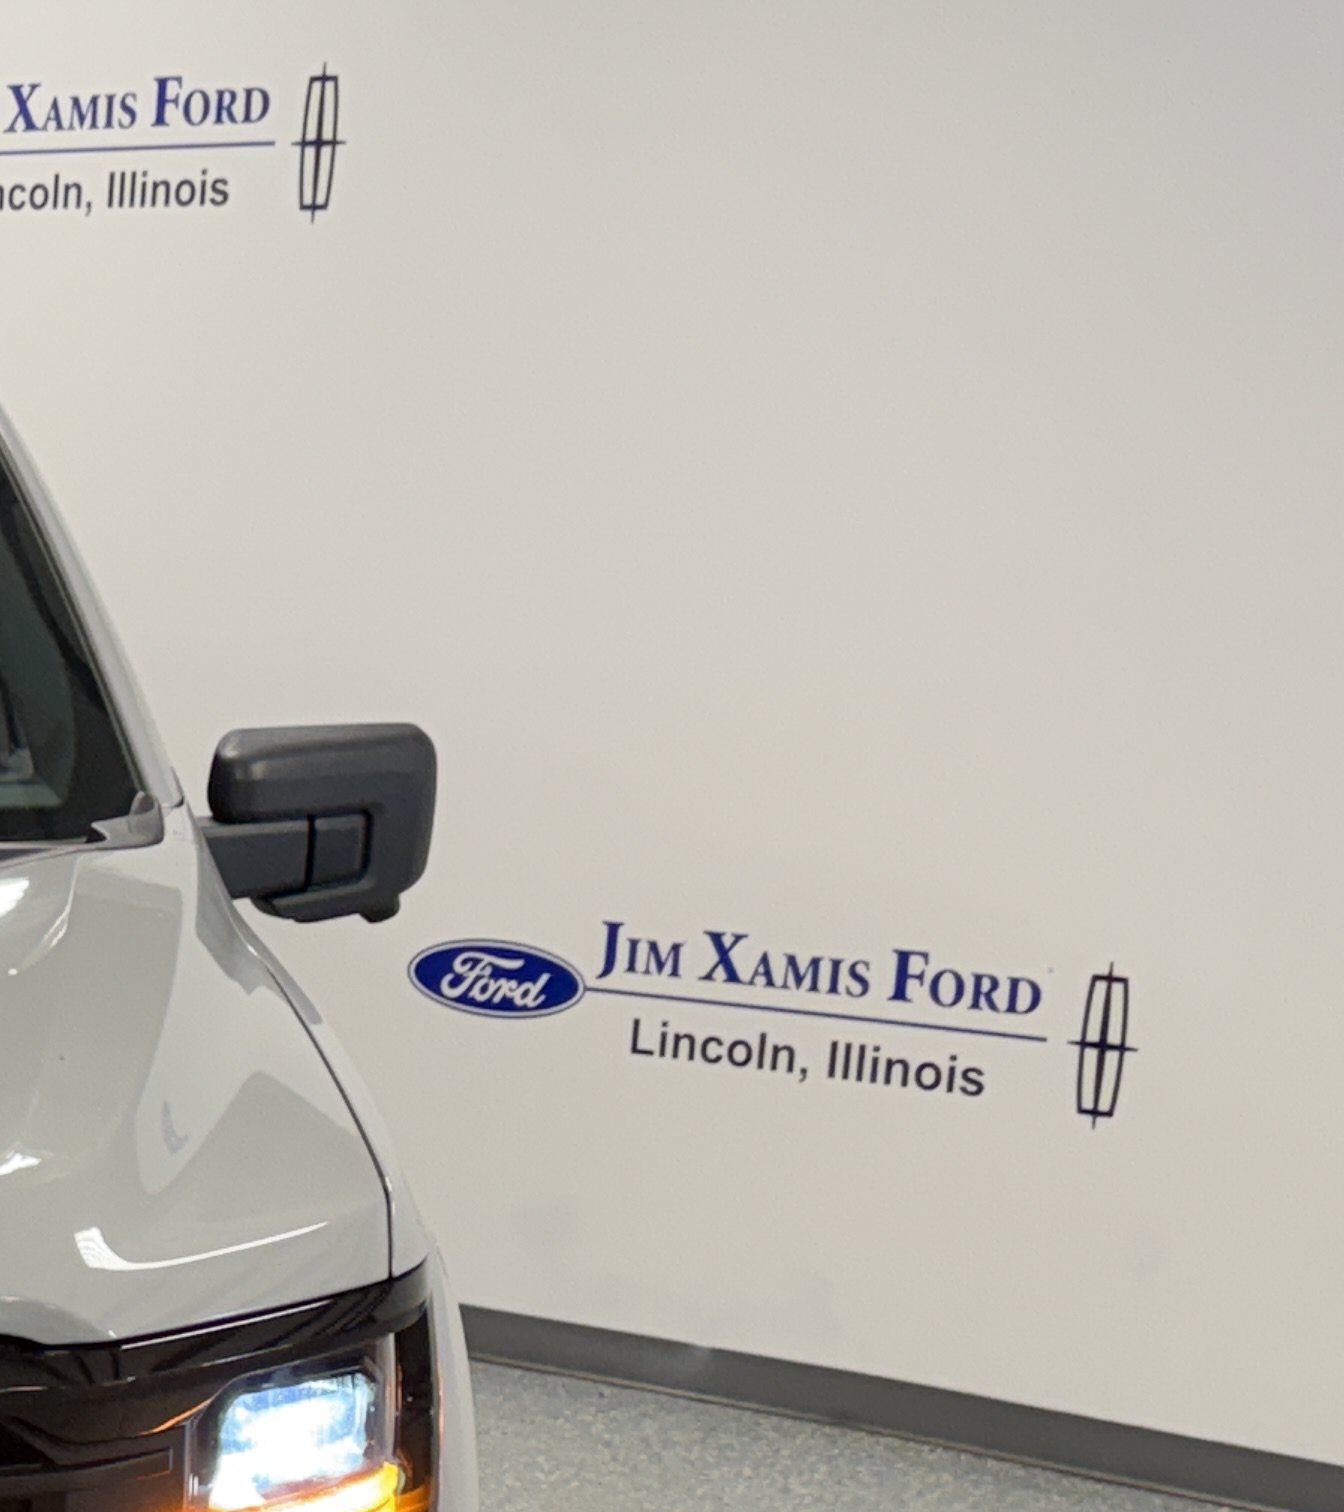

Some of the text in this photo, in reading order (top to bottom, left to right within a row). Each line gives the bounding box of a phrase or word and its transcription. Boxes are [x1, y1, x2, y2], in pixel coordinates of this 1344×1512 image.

[3, 82, 138, 134] XAMIS
[150, 75, 271, 128] FORD
[107, 168, 230, 209] Illinois
[438, 948, 548, 1012] Ford
[595, 920, 1043, 1016] JIM XAMIS FORD
[629, 1017, 986, 1098] Lincoln, Illinois
